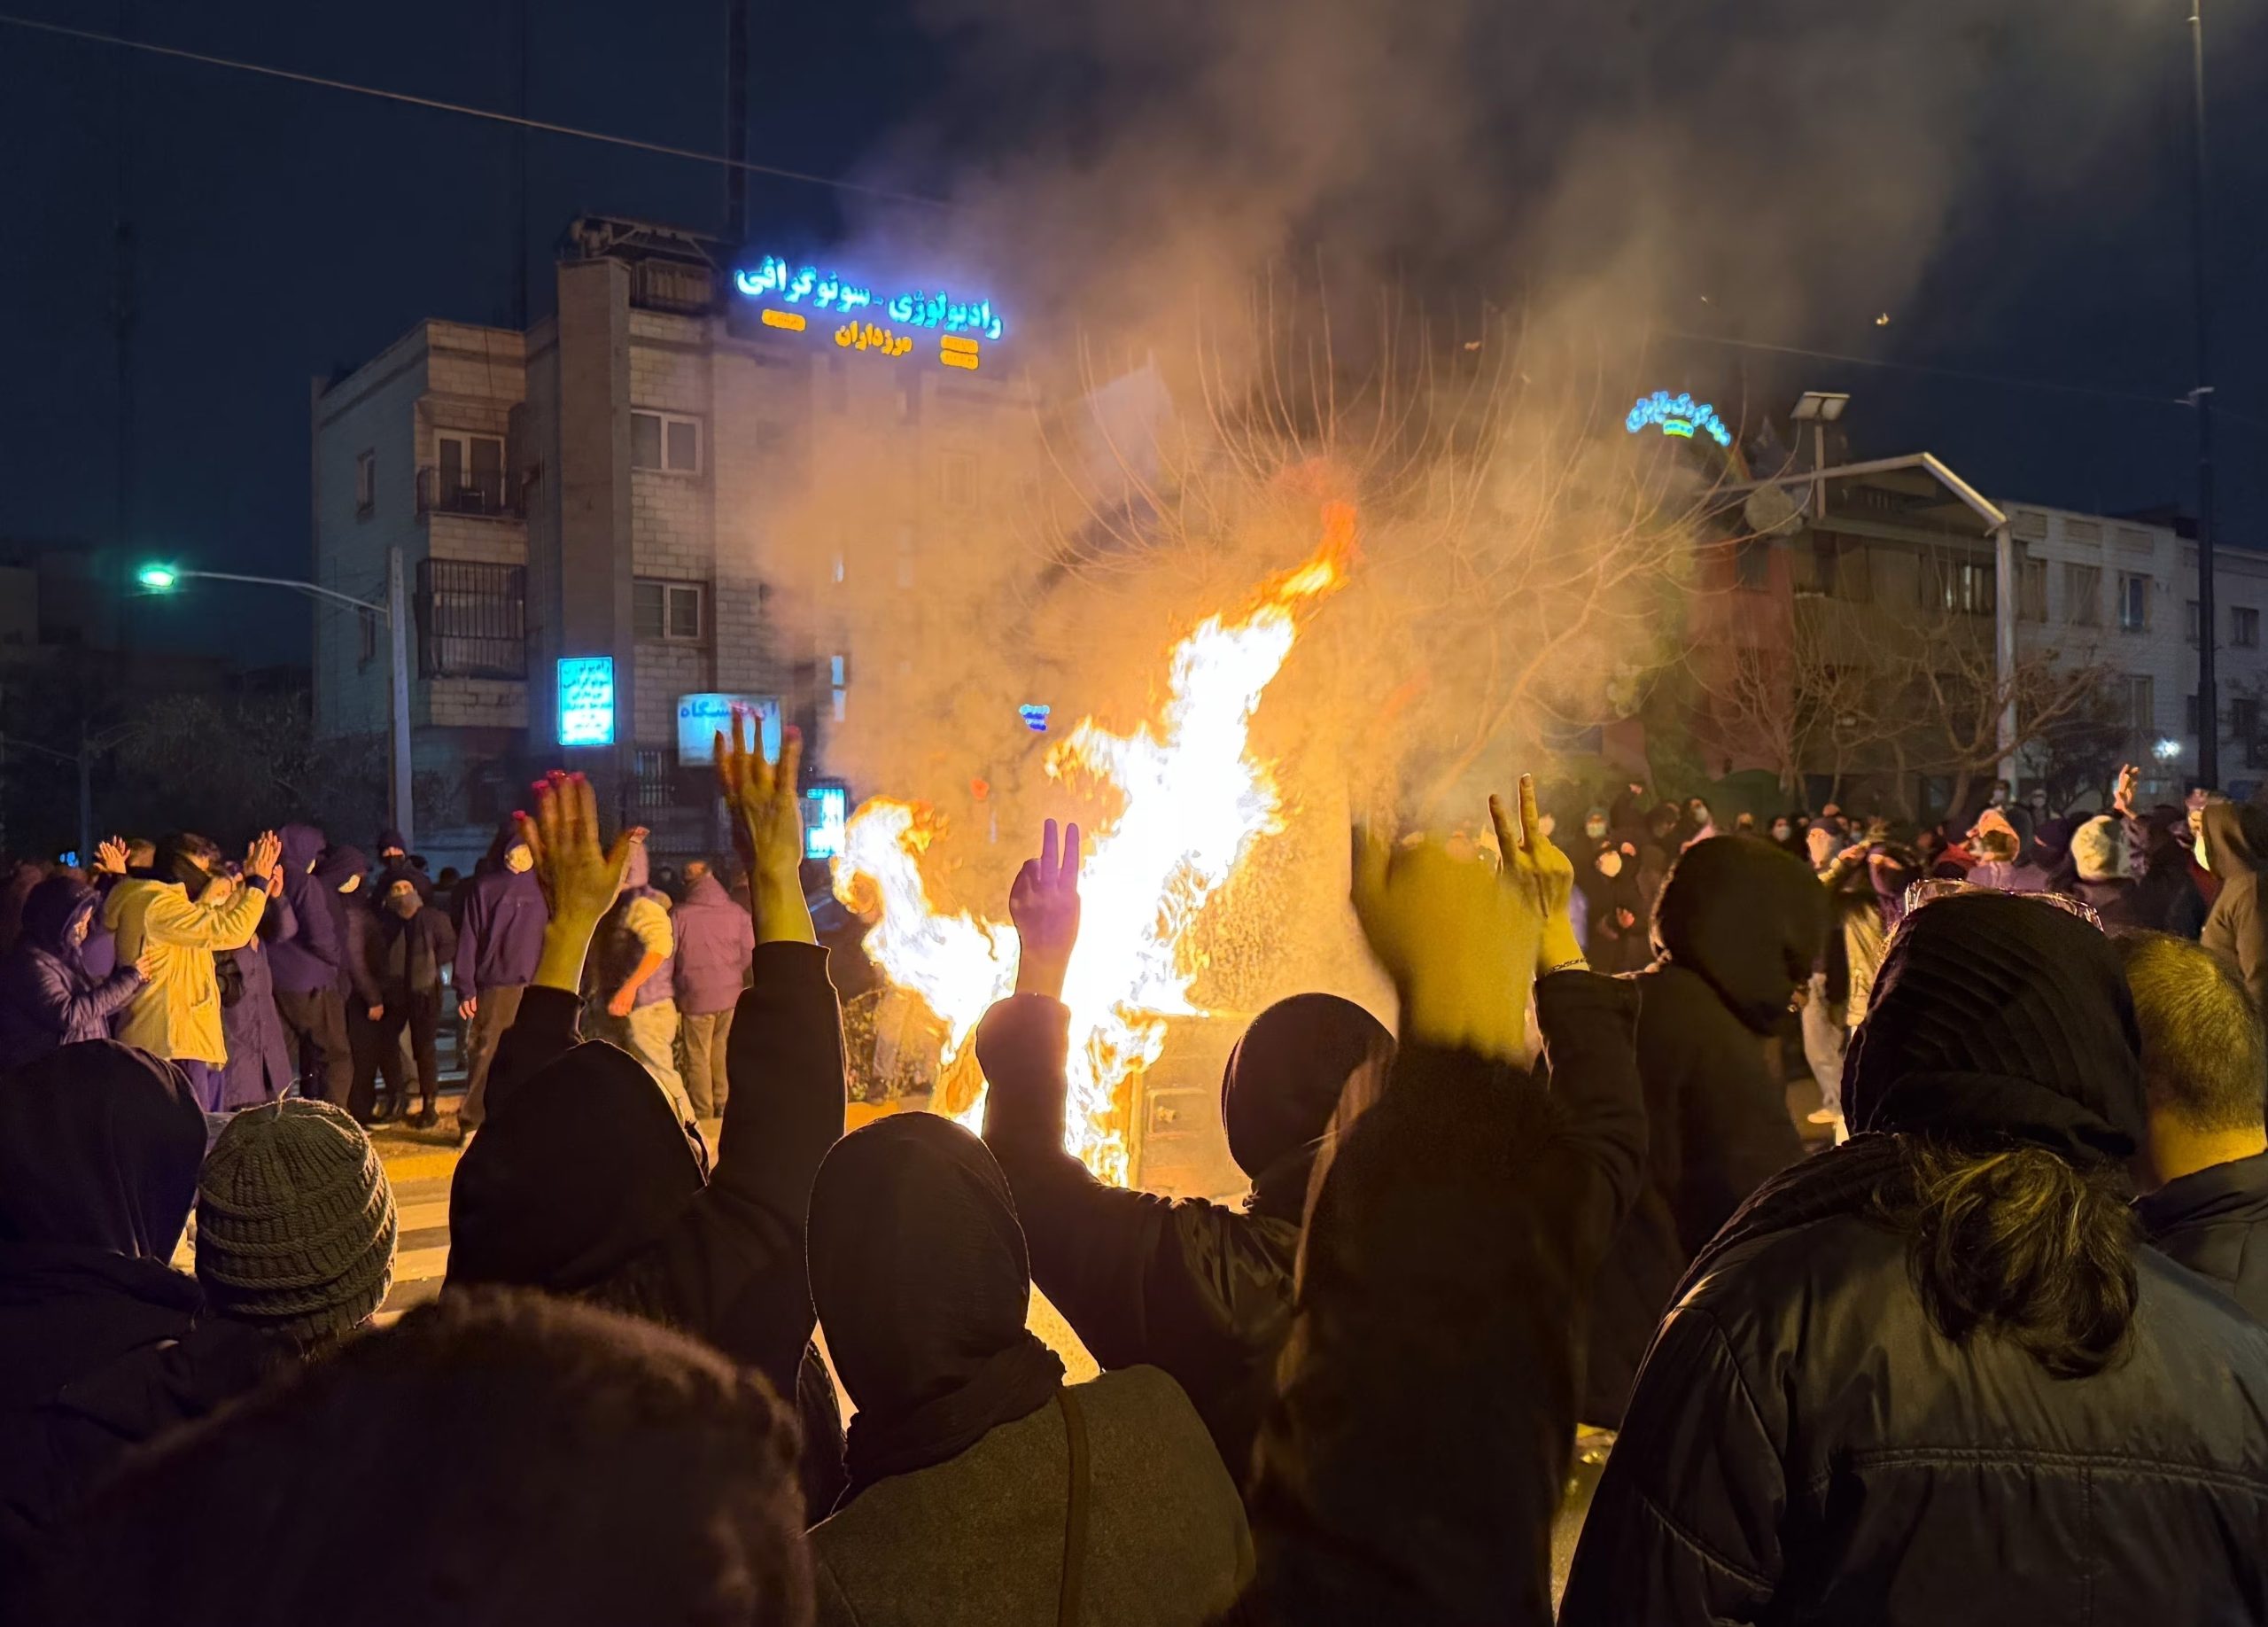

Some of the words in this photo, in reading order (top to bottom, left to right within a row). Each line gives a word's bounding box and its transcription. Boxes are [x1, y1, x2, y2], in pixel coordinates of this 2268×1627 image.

[734, 255, 872, 314] سونوگرافی
[835, 320, 913, 356] مرزداران
[888, 290, 1004, 340] رادیولوژی
